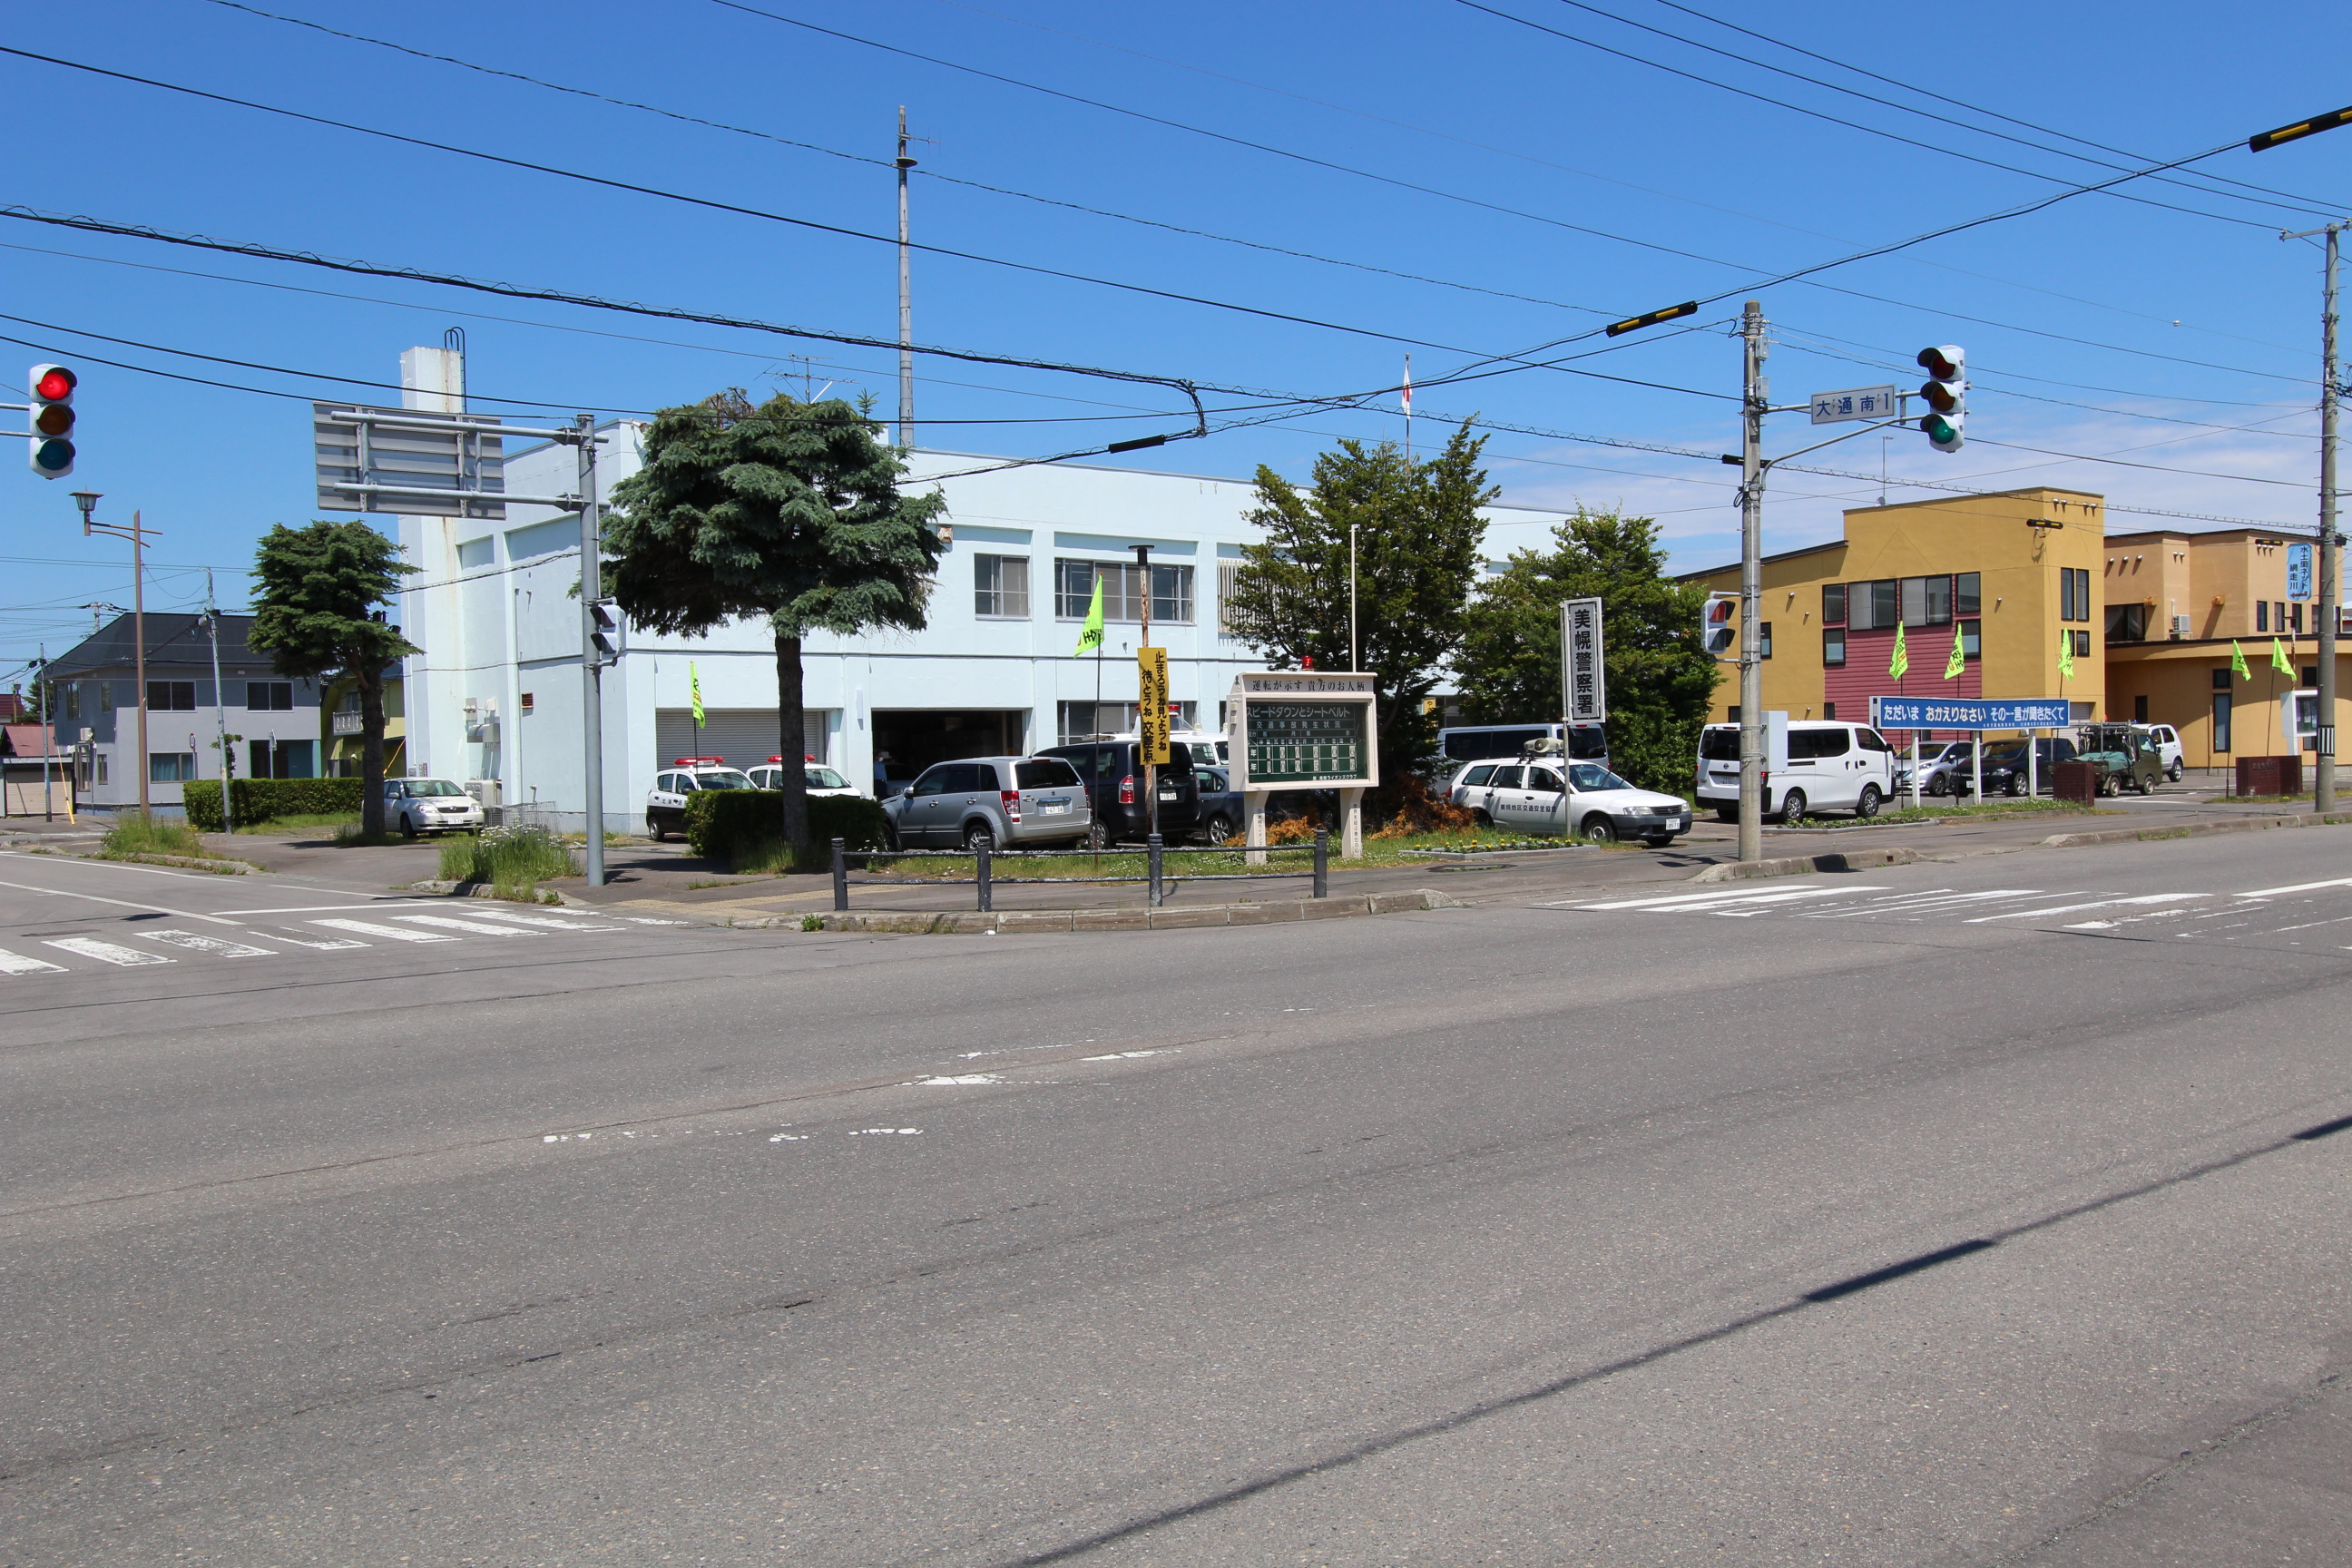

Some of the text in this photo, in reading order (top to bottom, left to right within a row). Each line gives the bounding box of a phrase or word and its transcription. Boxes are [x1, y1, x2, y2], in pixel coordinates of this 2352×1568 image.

[1816, 393, 1889, 417] 大通南1
[1574, 609, 1593, 714] 美幌警察署
[1142, 670, 1152, 717] 待とうね
[1252, 680, 1365, 691] 運転が示す 貴方のお人柄
[1247, 706, 1350, 718] スピードダウンとシートベルト
[1884, 704, 2064, 722] ただいま おかえりなさい その一言が聞きたくて
[1256, 720, 1341, 730] 交通事故発生状況
